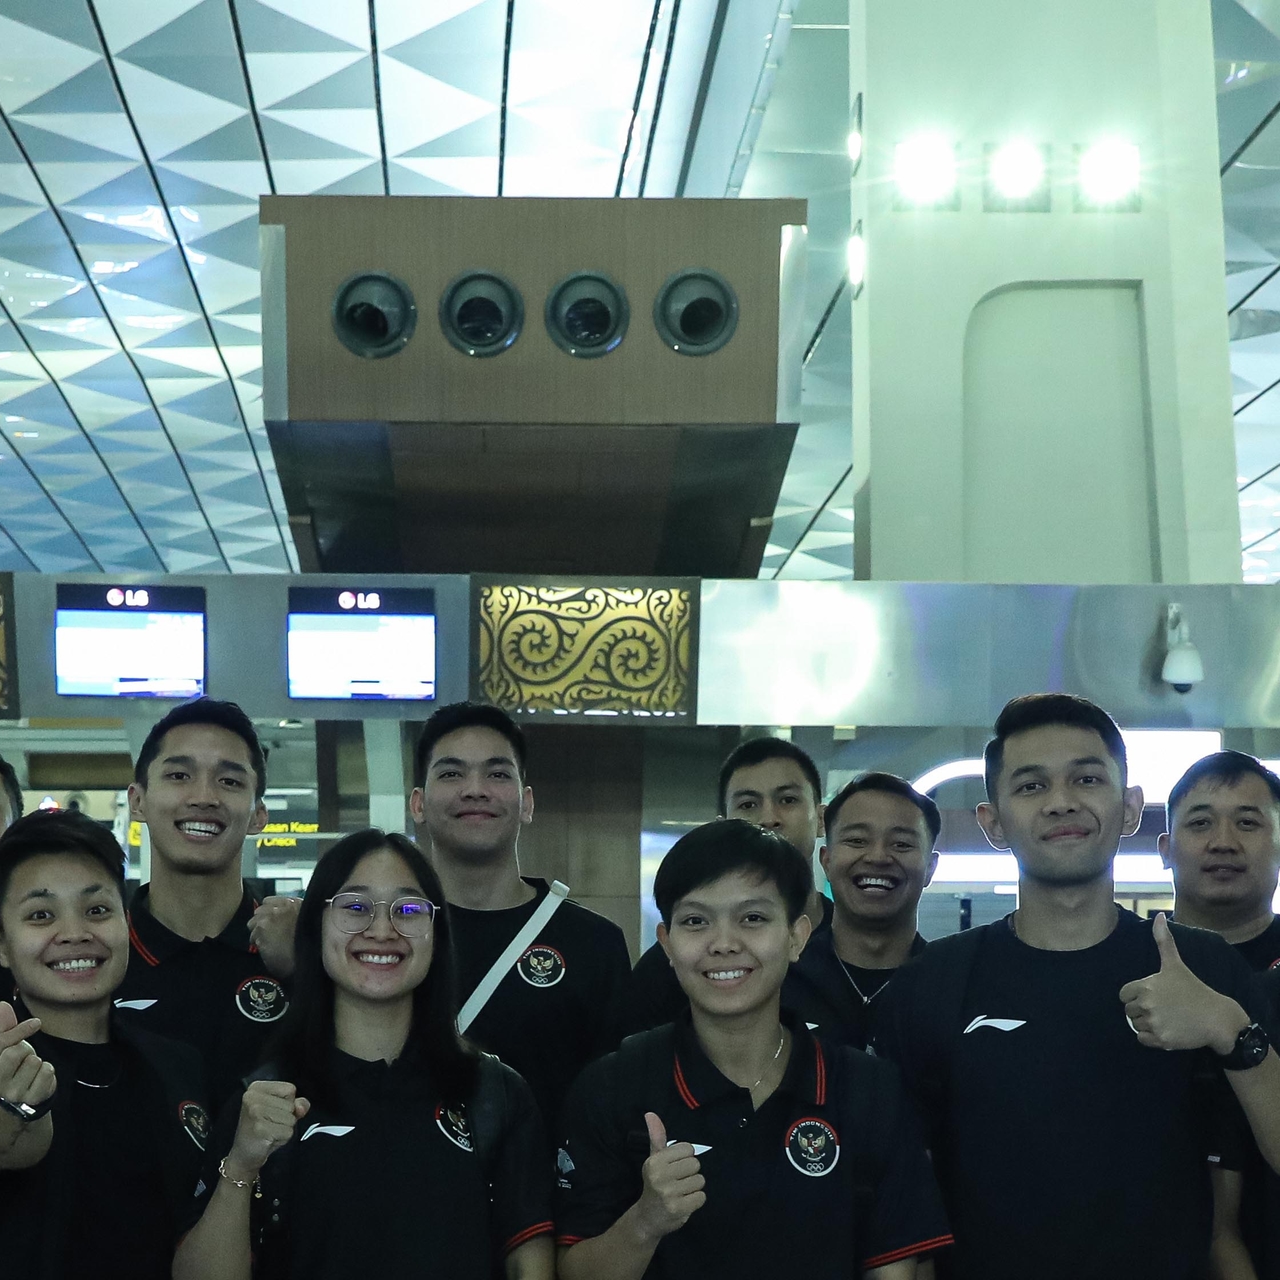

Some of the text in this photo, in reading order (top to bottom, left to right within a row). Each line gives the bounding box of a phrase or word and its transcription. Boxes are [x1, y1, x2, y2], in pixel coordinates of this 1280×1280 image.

[126, 590, 149, 607] LG
[358, 593, 381, 609] LG
[789, 1127, 799, 1142] TIM
